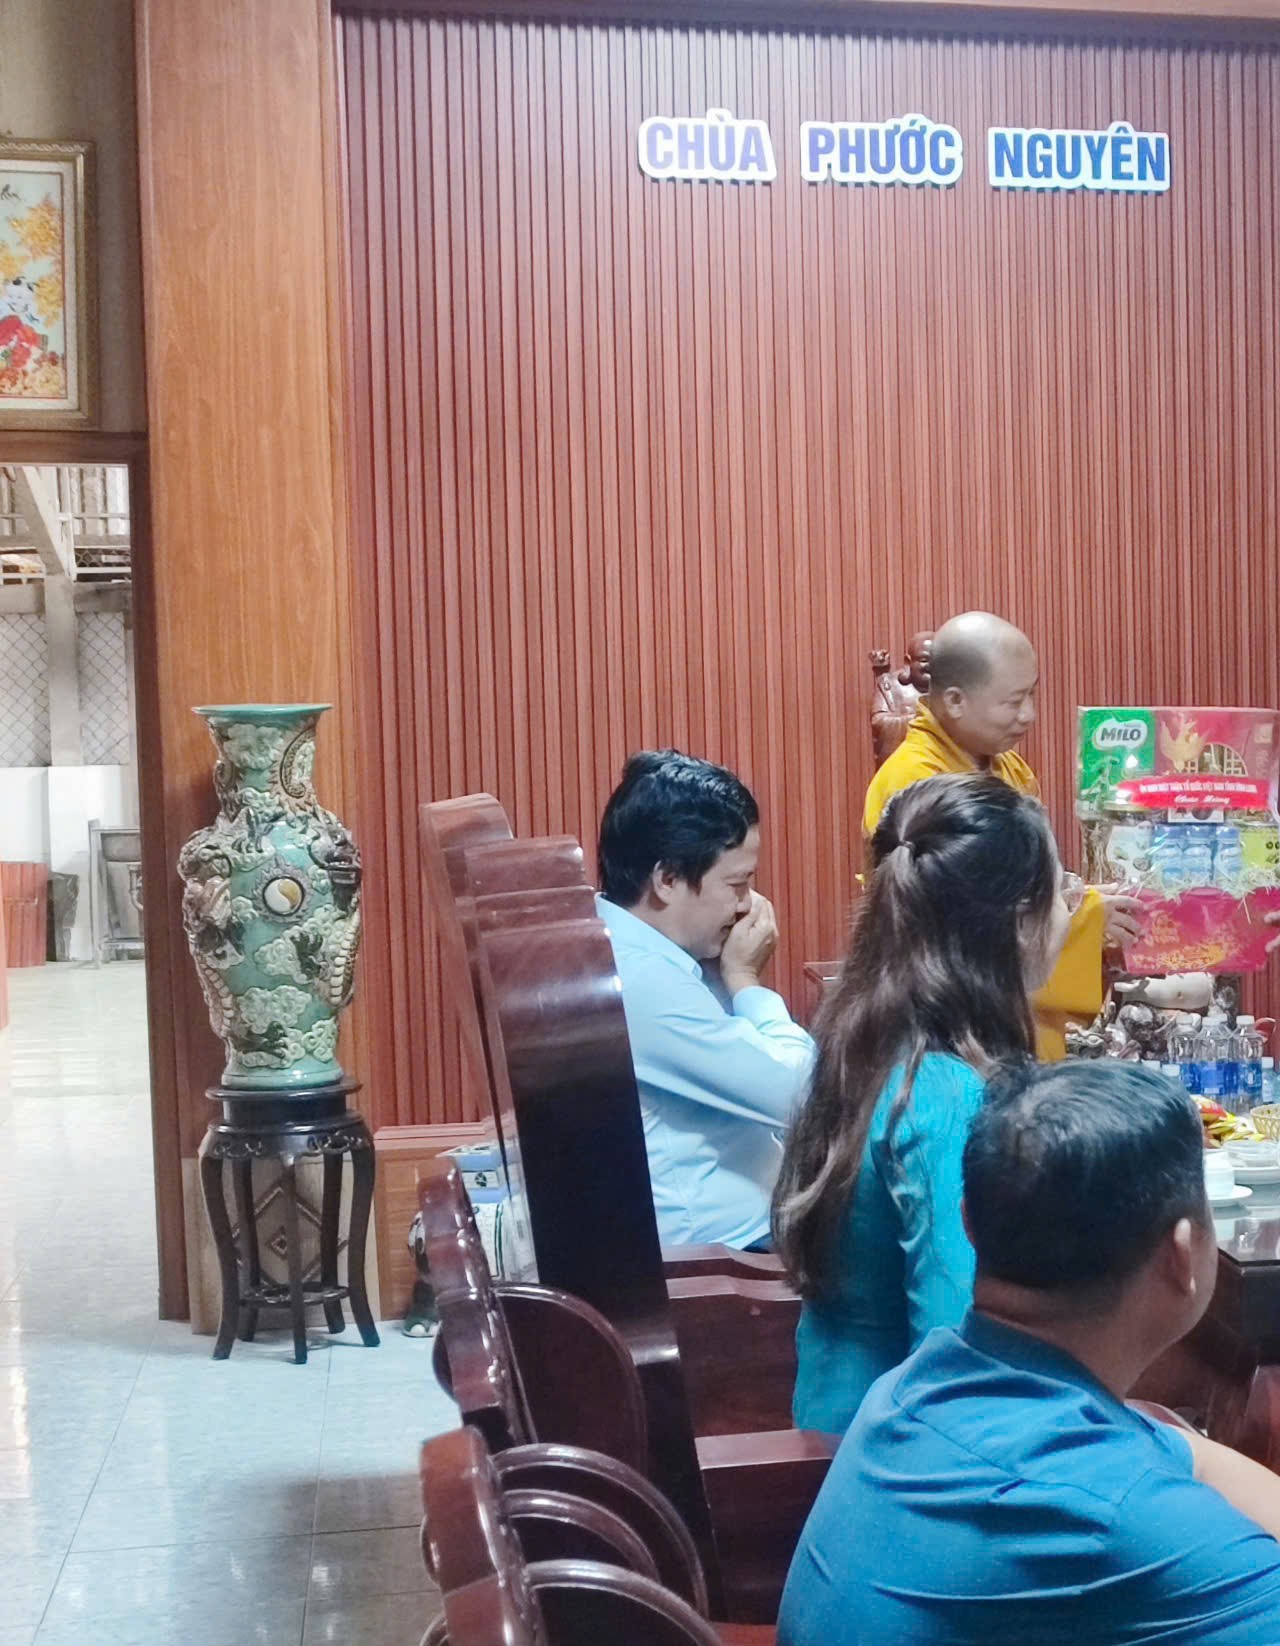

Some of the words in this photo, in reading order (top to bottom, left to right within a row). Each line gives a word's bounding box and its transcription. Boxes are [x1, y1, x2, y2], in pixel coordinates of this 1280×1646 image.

[645, 114, 769, 172] CHÙA
[808, 119, 955, 176] PHƯỚC
[993, 126, 1166, 181] NGUYÊN
[1100, 727, 1142, 741] MILO
